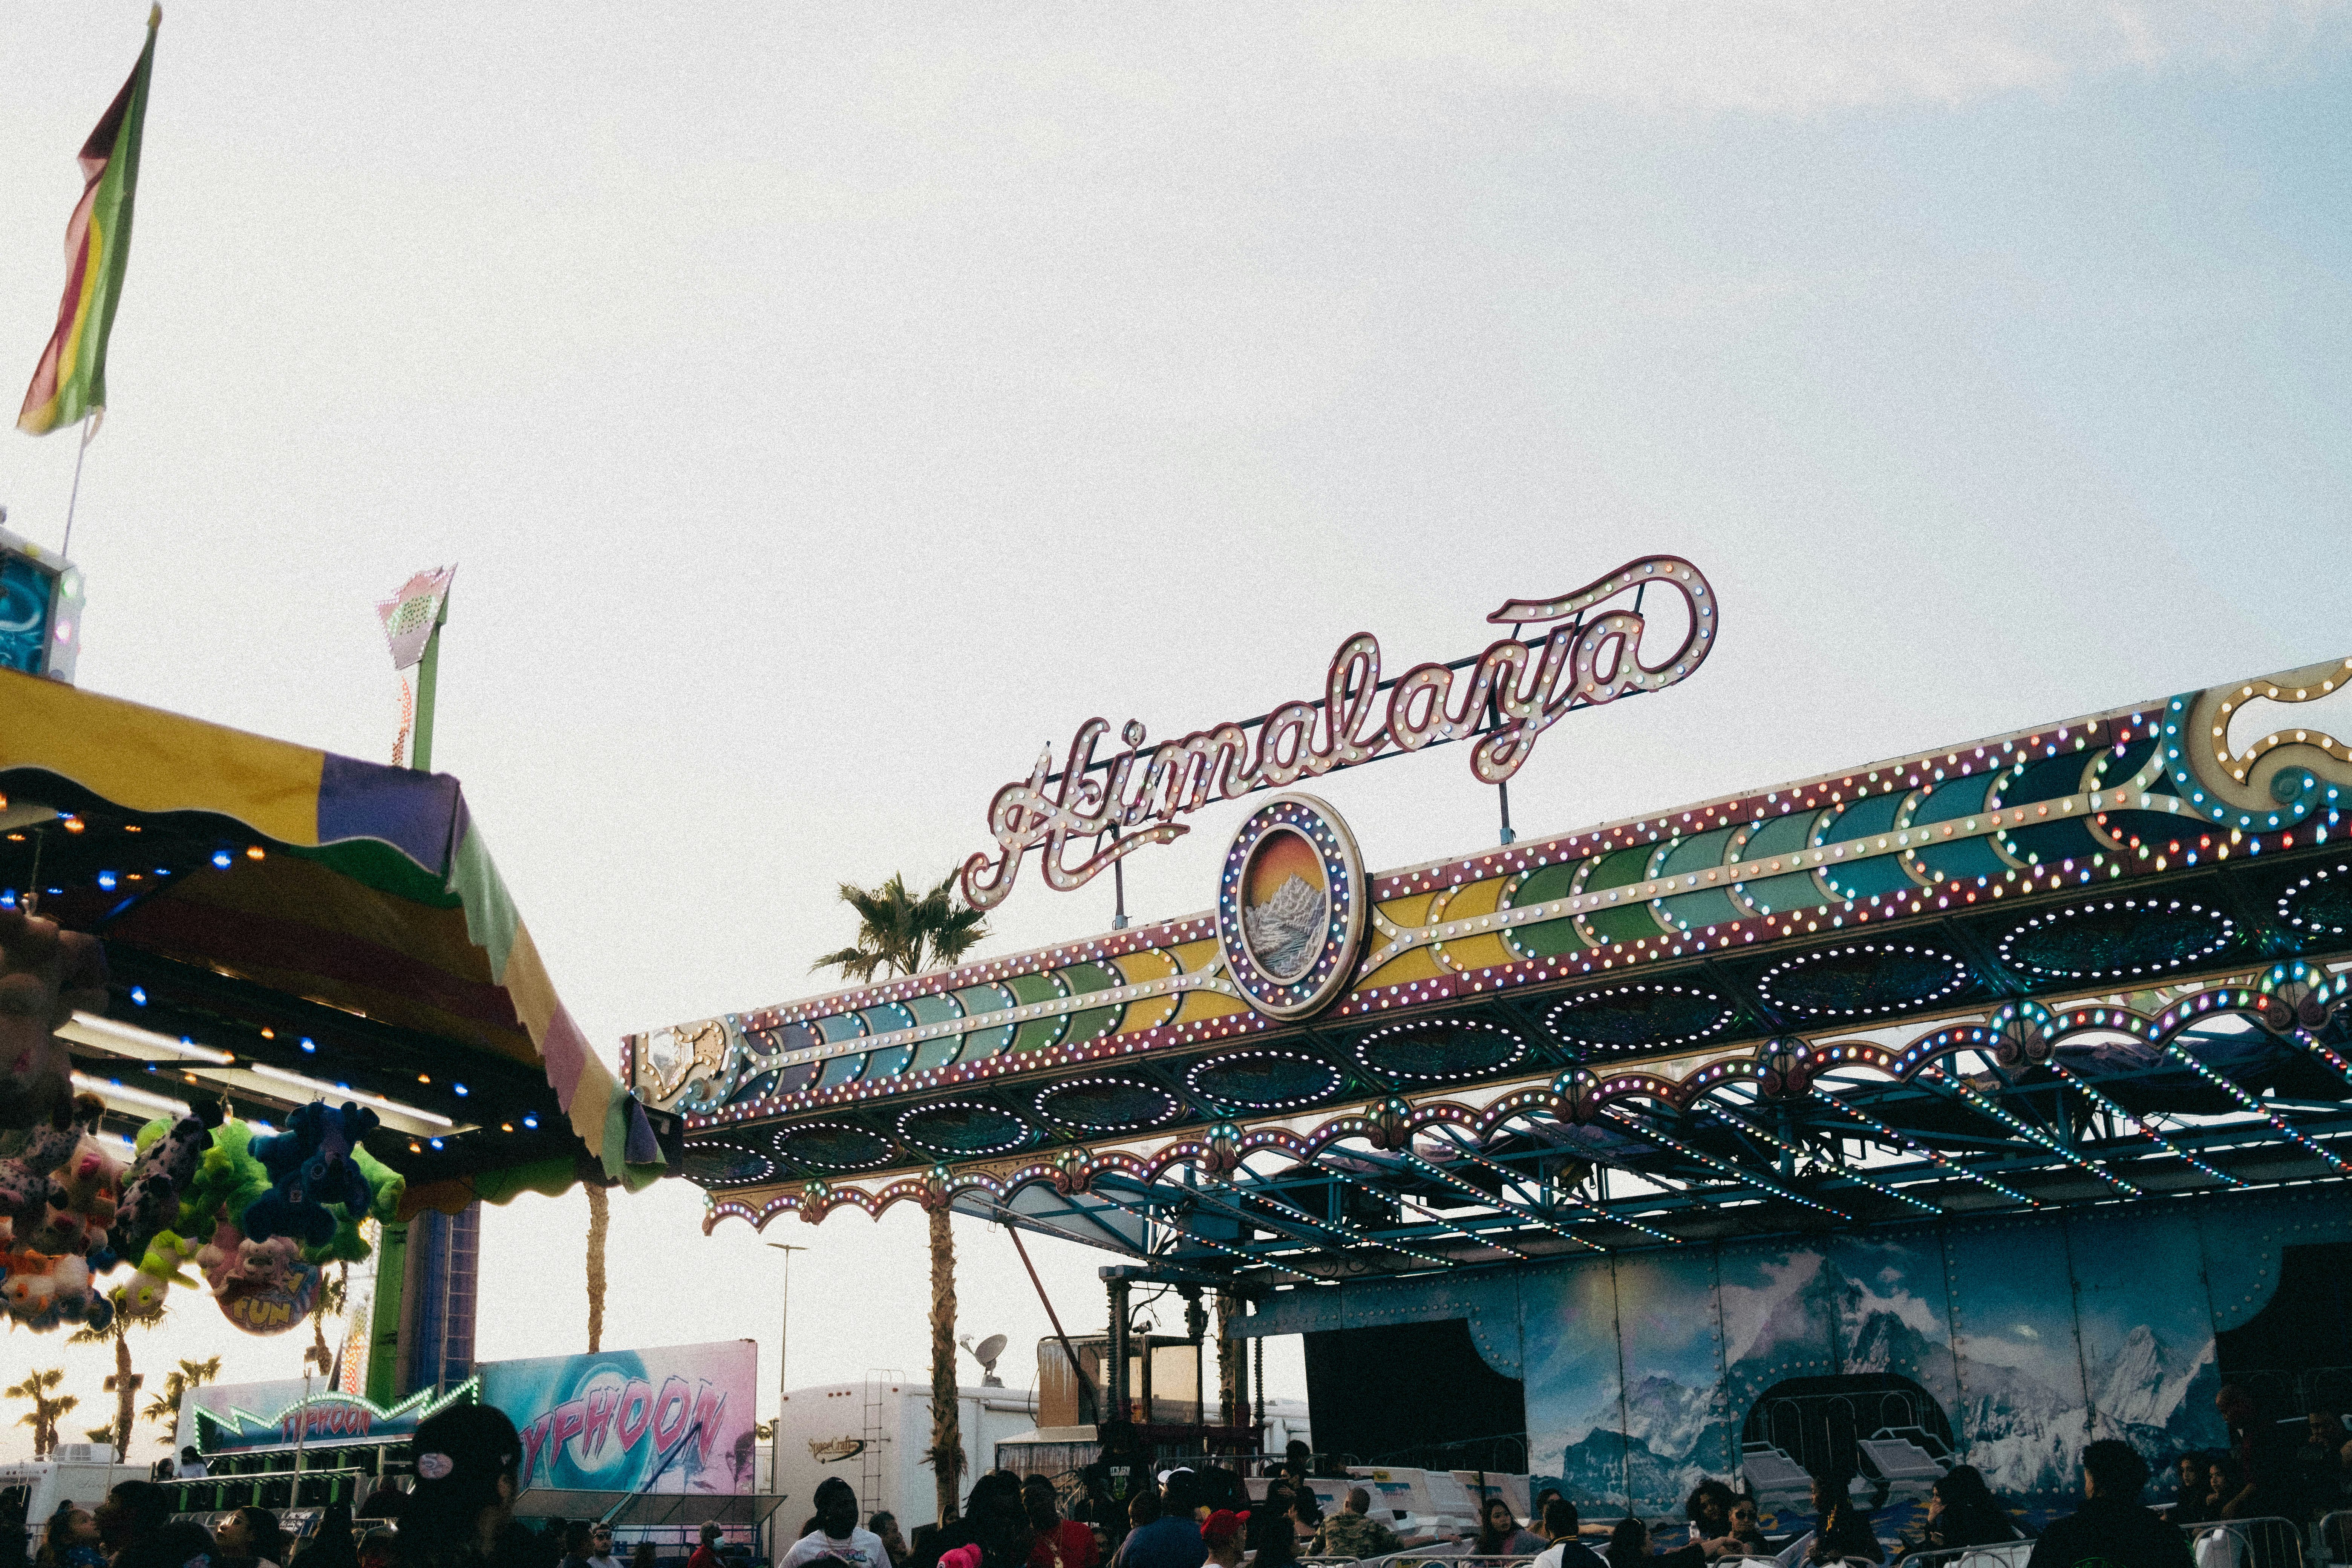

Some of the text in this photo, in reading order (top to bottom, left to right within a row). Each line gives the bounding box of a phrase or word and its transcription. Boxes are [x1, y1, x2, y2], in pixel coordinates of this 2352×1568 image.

[962, 554, 1719, 911] Himalaya
[233, 1296, 291, 1326] FUN
[281, 1401, 372, 1445] TYPHOON
[520, 1375, 727, 1488] YPHOON
